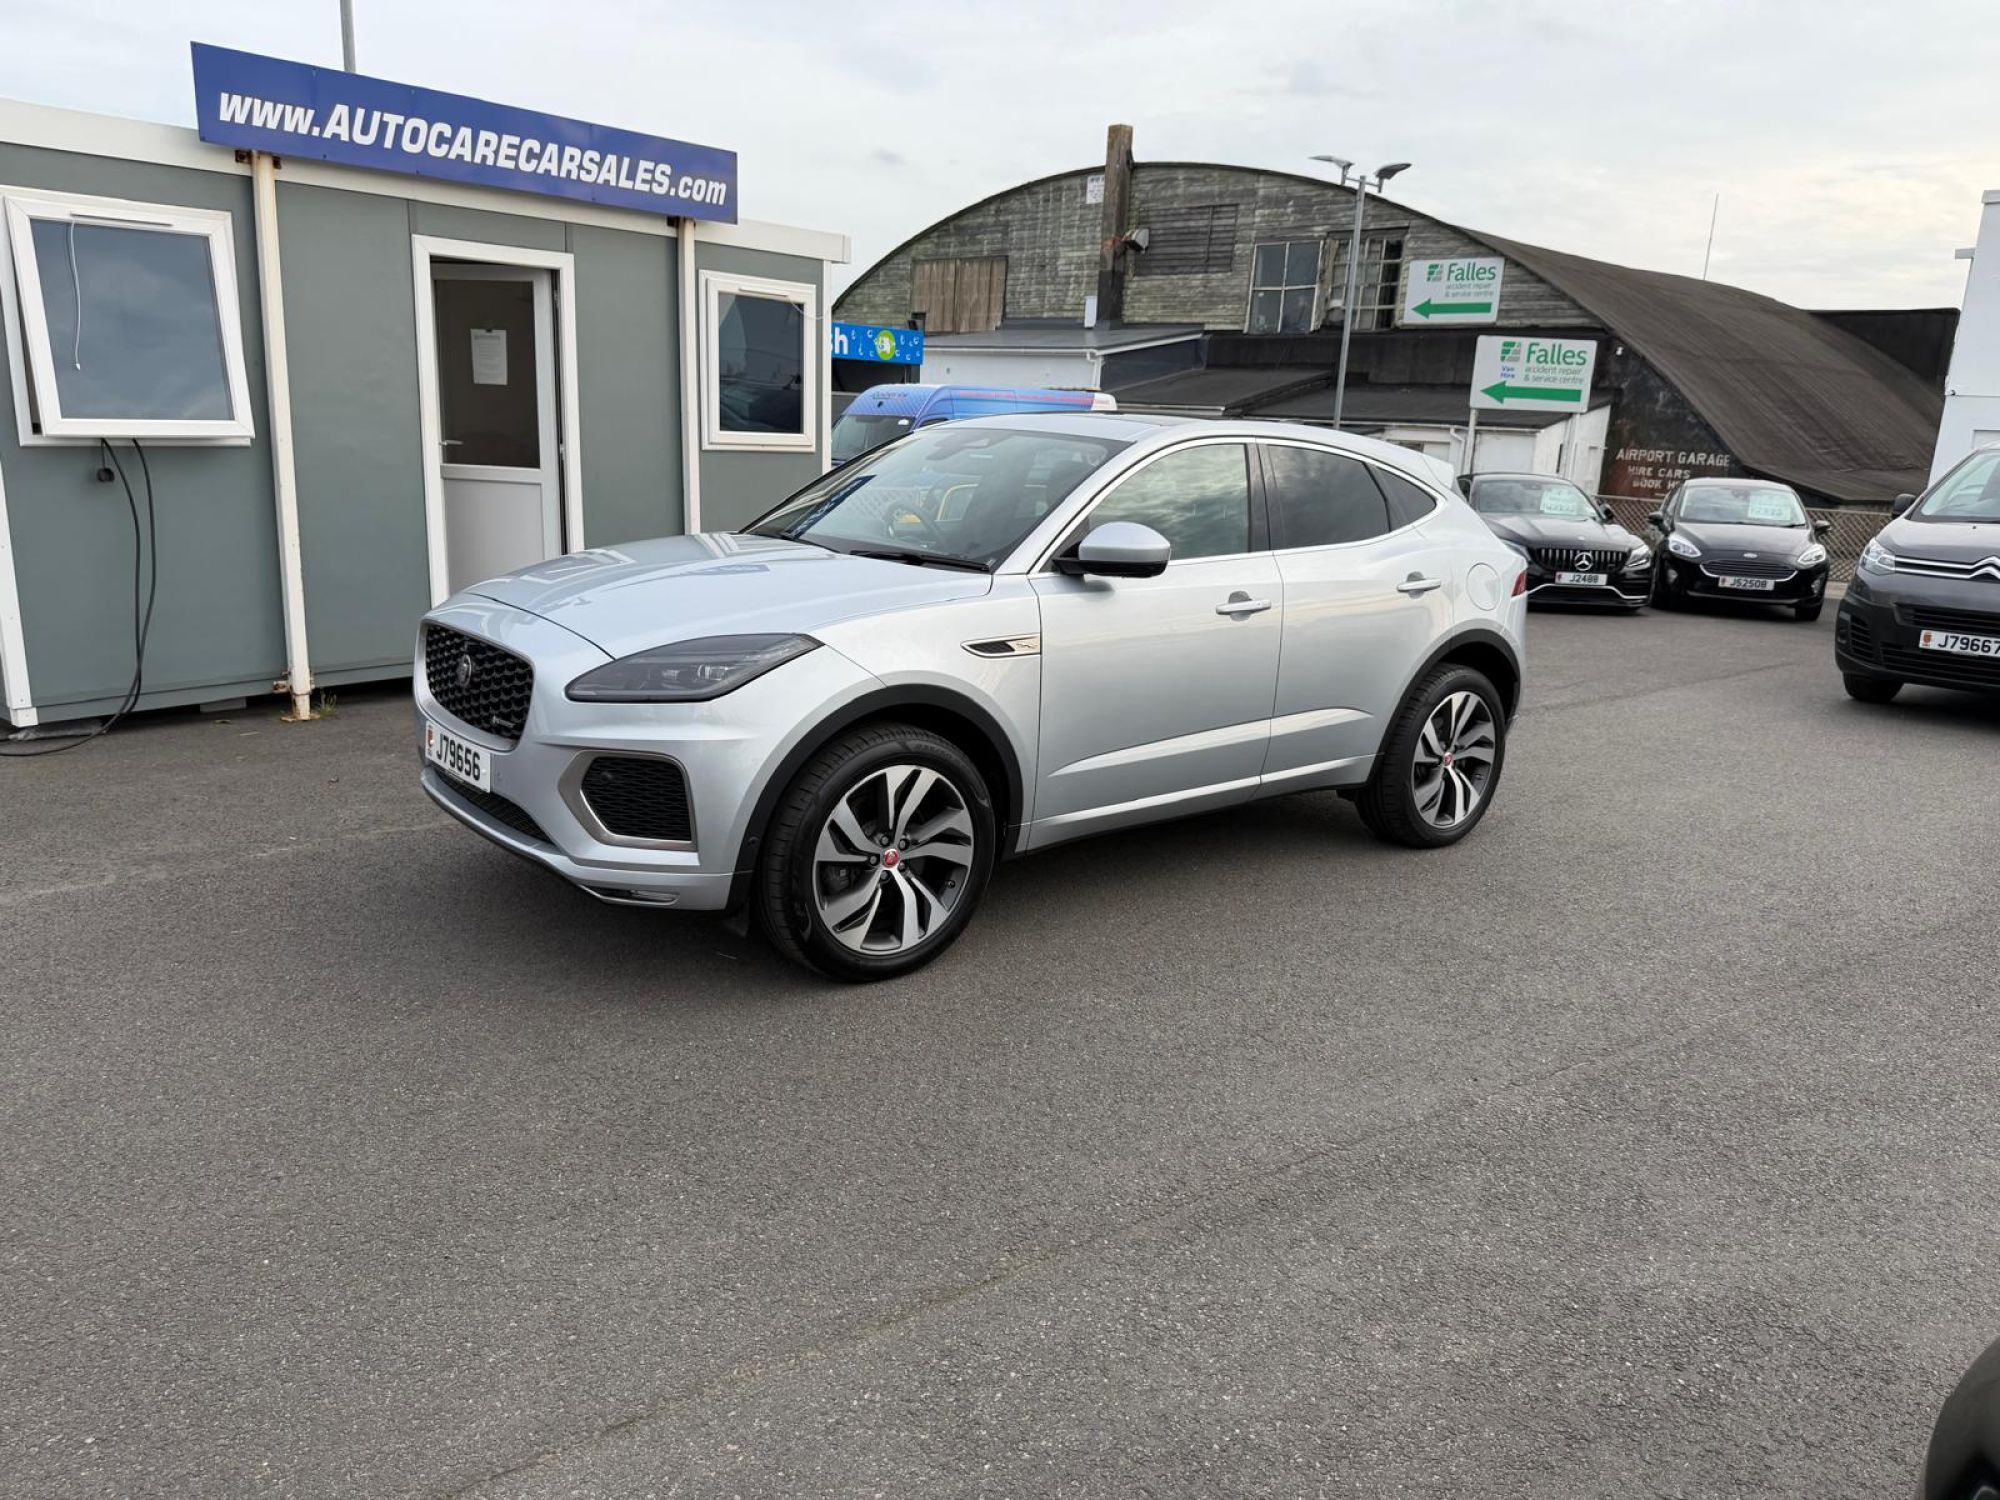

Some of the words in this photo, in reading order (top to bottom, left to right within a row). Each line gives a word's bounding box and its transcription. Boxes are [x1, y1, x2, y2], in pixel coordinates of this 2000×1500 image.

[1447, 262, 1497, 281] Falles
[1526, 342, 1587, 365] Falles
[1531, 374, 1558, 382] service
[1559, 375, 1585, 384] centre
[1559, 367, 1582, 376] repair
[1616, 448, 1675, 463] AIRPORT
[1678, 451, 1731, 467] GARAGE
[1628, 465, 1653, 477] HIRE
[1658, 468, 1691, 479] CARS
[1938, 634, 2000, 655] J79667
[436, 733, 480, 781] J79656
